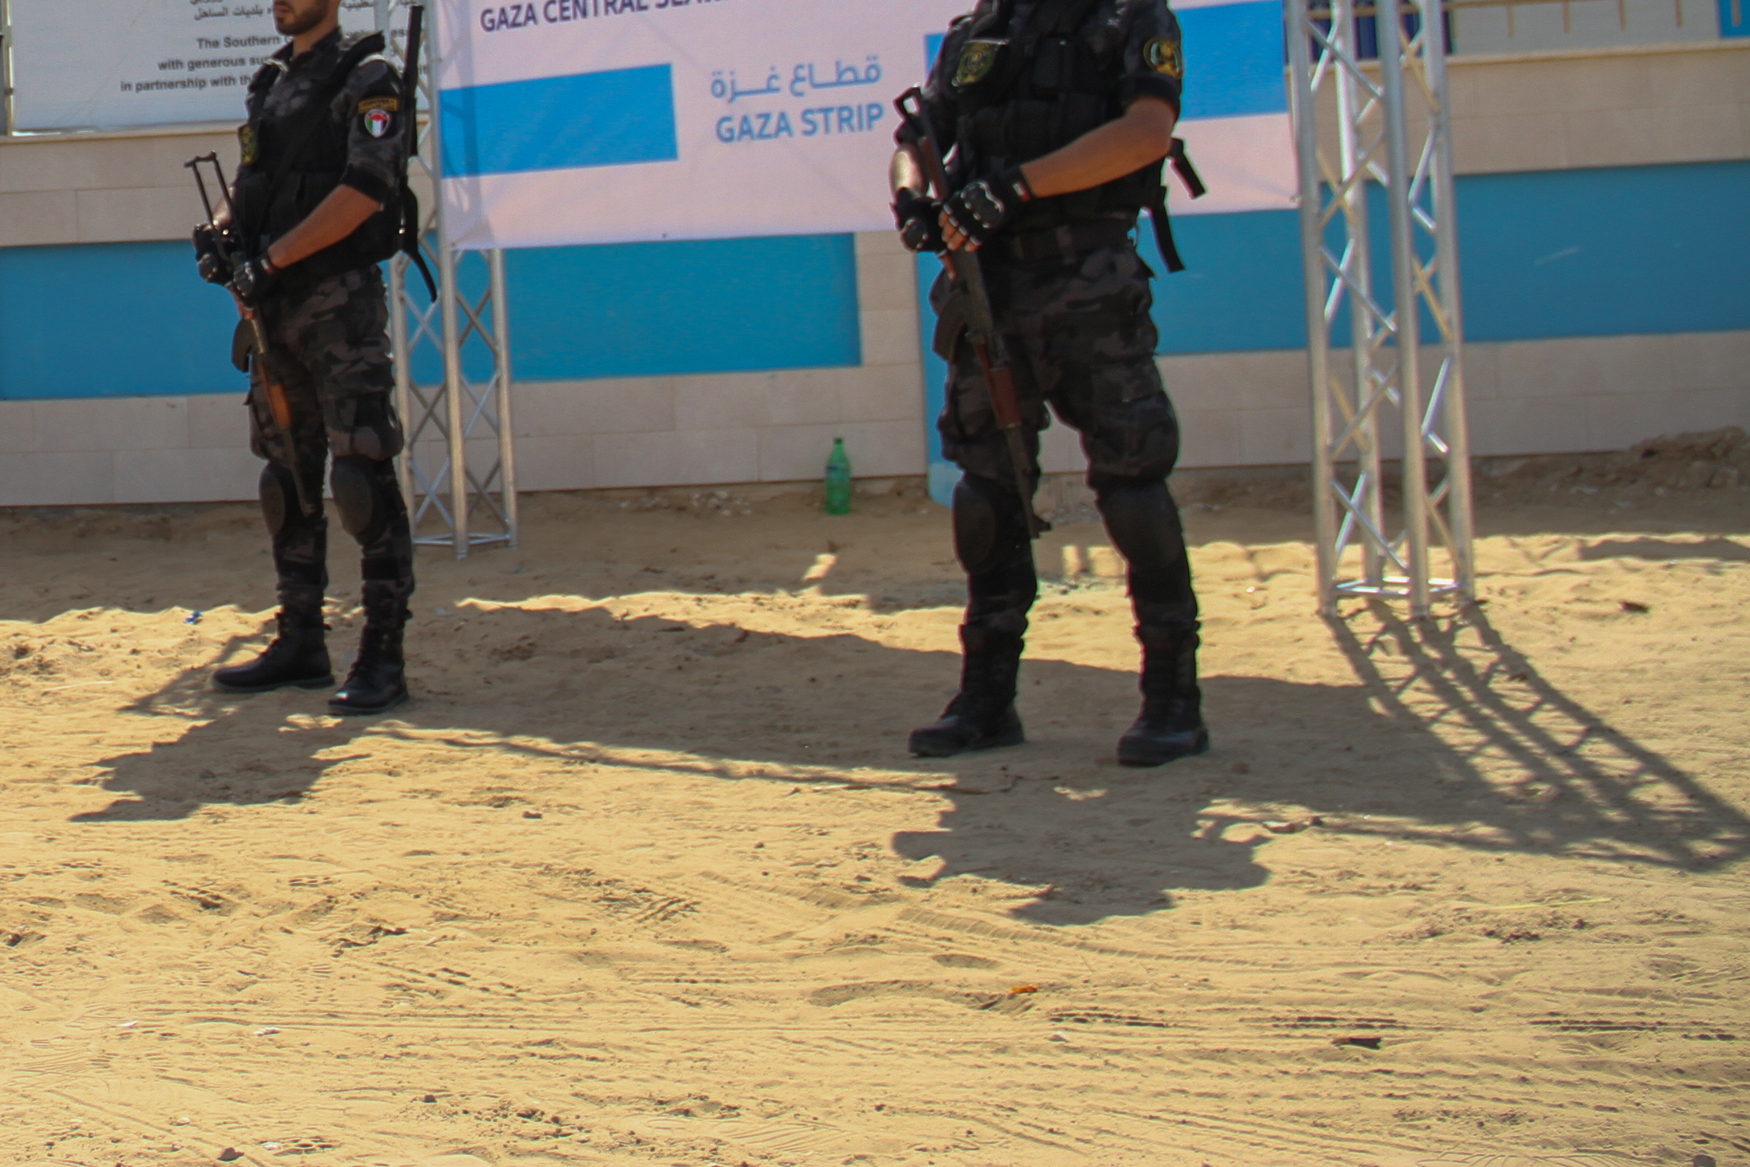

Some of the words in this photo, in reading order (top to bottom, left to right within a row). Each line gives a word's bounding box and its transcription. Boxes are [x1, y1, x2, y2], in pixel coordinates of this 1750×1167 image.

[480, 2, 538, 32] GAZA
[196, 38, 220, 49] The
[223, 36, 280, 48] Southern
[157, 59, 184, 70] with
[187, 57, 246, 71] generous
[789, 55, 883, 97] قطاع
[121, 81, 132, 91] in
[135, 78, 207, 93] partnership
[209, 76, 236, 87] with
[239, 74, 253, 85] th
[710, 66, 781, 104] غزة
[716, 111, 793, 143] GAZA
[801, 102, 884, 136] STRIP
